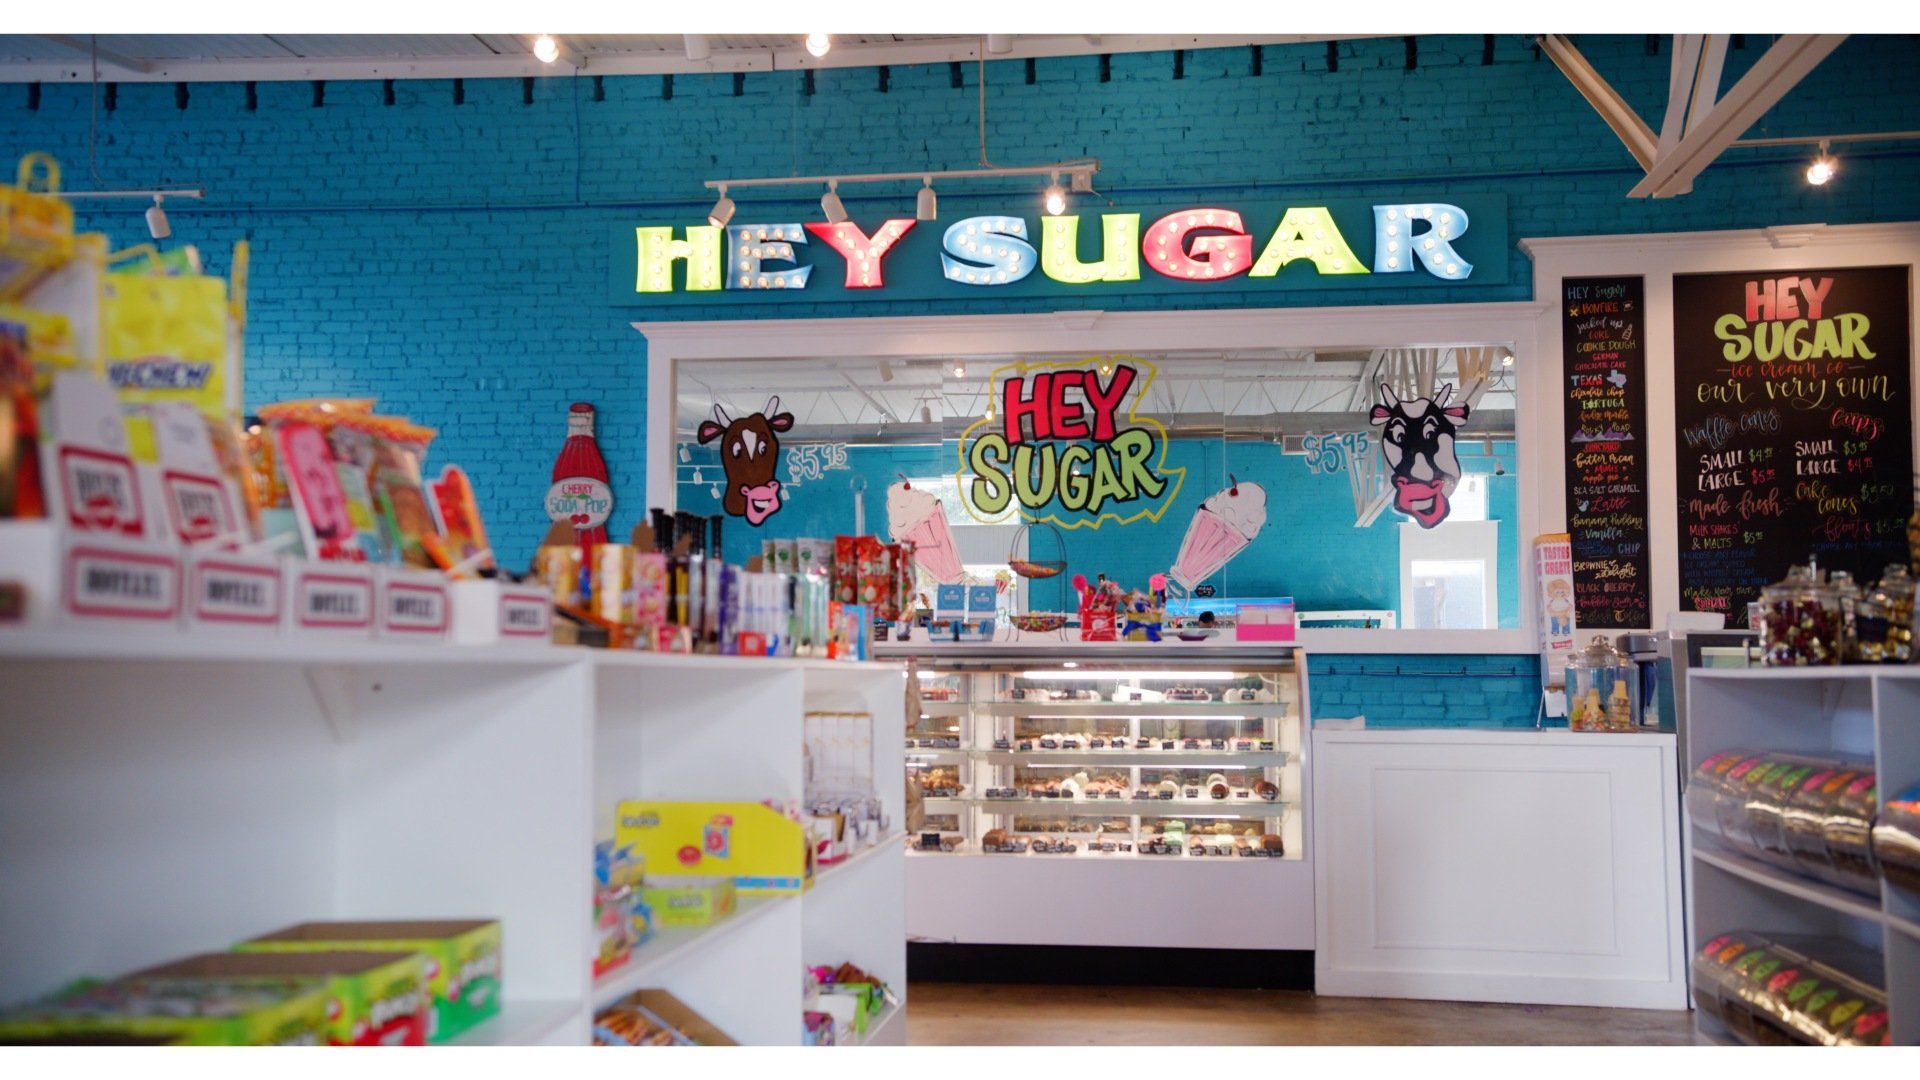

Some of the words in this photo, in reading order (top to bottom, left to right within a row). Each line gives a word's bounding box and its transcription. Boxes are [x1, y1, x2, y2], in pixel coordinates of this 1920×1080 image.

[636, 219, 917, 292] HEY
[940, 203, 1473, 286] SUGAR
[1567, 287, 1589, 299] HEY
[1745, 276, 1834, 321] HEY
[1582, 302, 1619, 314] BONFIRE
[1714, 313, 1876, 362] SUGAR
[1576, 342, 1606, 353] COOKIE
[1609, 340, 1636, 351] DOUGH
[1730, 363, 1753, 378] ice
[1760, 361, 1818, 378] cream
[1571, 375, 1604, 387] TEXAS
[1697, 378, 1754, 403] our
[1765, 379, 1833, 410] very
[1836, 375, 1896, 402] own
[1003, 364, 1137, 446] HEY
[1612, 421, 1631, 432] ROAD
[1302, 431, 1368, 474] $5.95
[1794, 439, 1839, 457] SMALL
[787, 443, 848, 483] $5.95
[1699, 450, 1745, 473] SMALL
[1795, 459, 1840, 475] LARGE
[969, 427, 1168, 515] SUGAR
[1698, 470, 1745, 491] LARGE
[562, 484, 592, 494] CHERRY
[1573, 486, 1588, 495] SEA
[1589, 485, 1606, 494] SALT
[1608, 484, 1640, 493] CARAMEL
[549, 497, 577, 513] SODA
[584, 497, 608, 513] POP
[1736, 487, 1783, 520] fresh
[1585, 528, 1623, 540] Vanilla
[1710, 522, 1739, 534] SHAKES
[1617, 543, 1641, 555] CHIP
[1692, 537, 1701, 550] &
[1704, 537, 1733, 549] MALTS
[1543, 546, 1570, 560] TASTES
[1573, 560, 1608, 572] BROWNIE
[1576, 582, 1600, 592] BLACK
